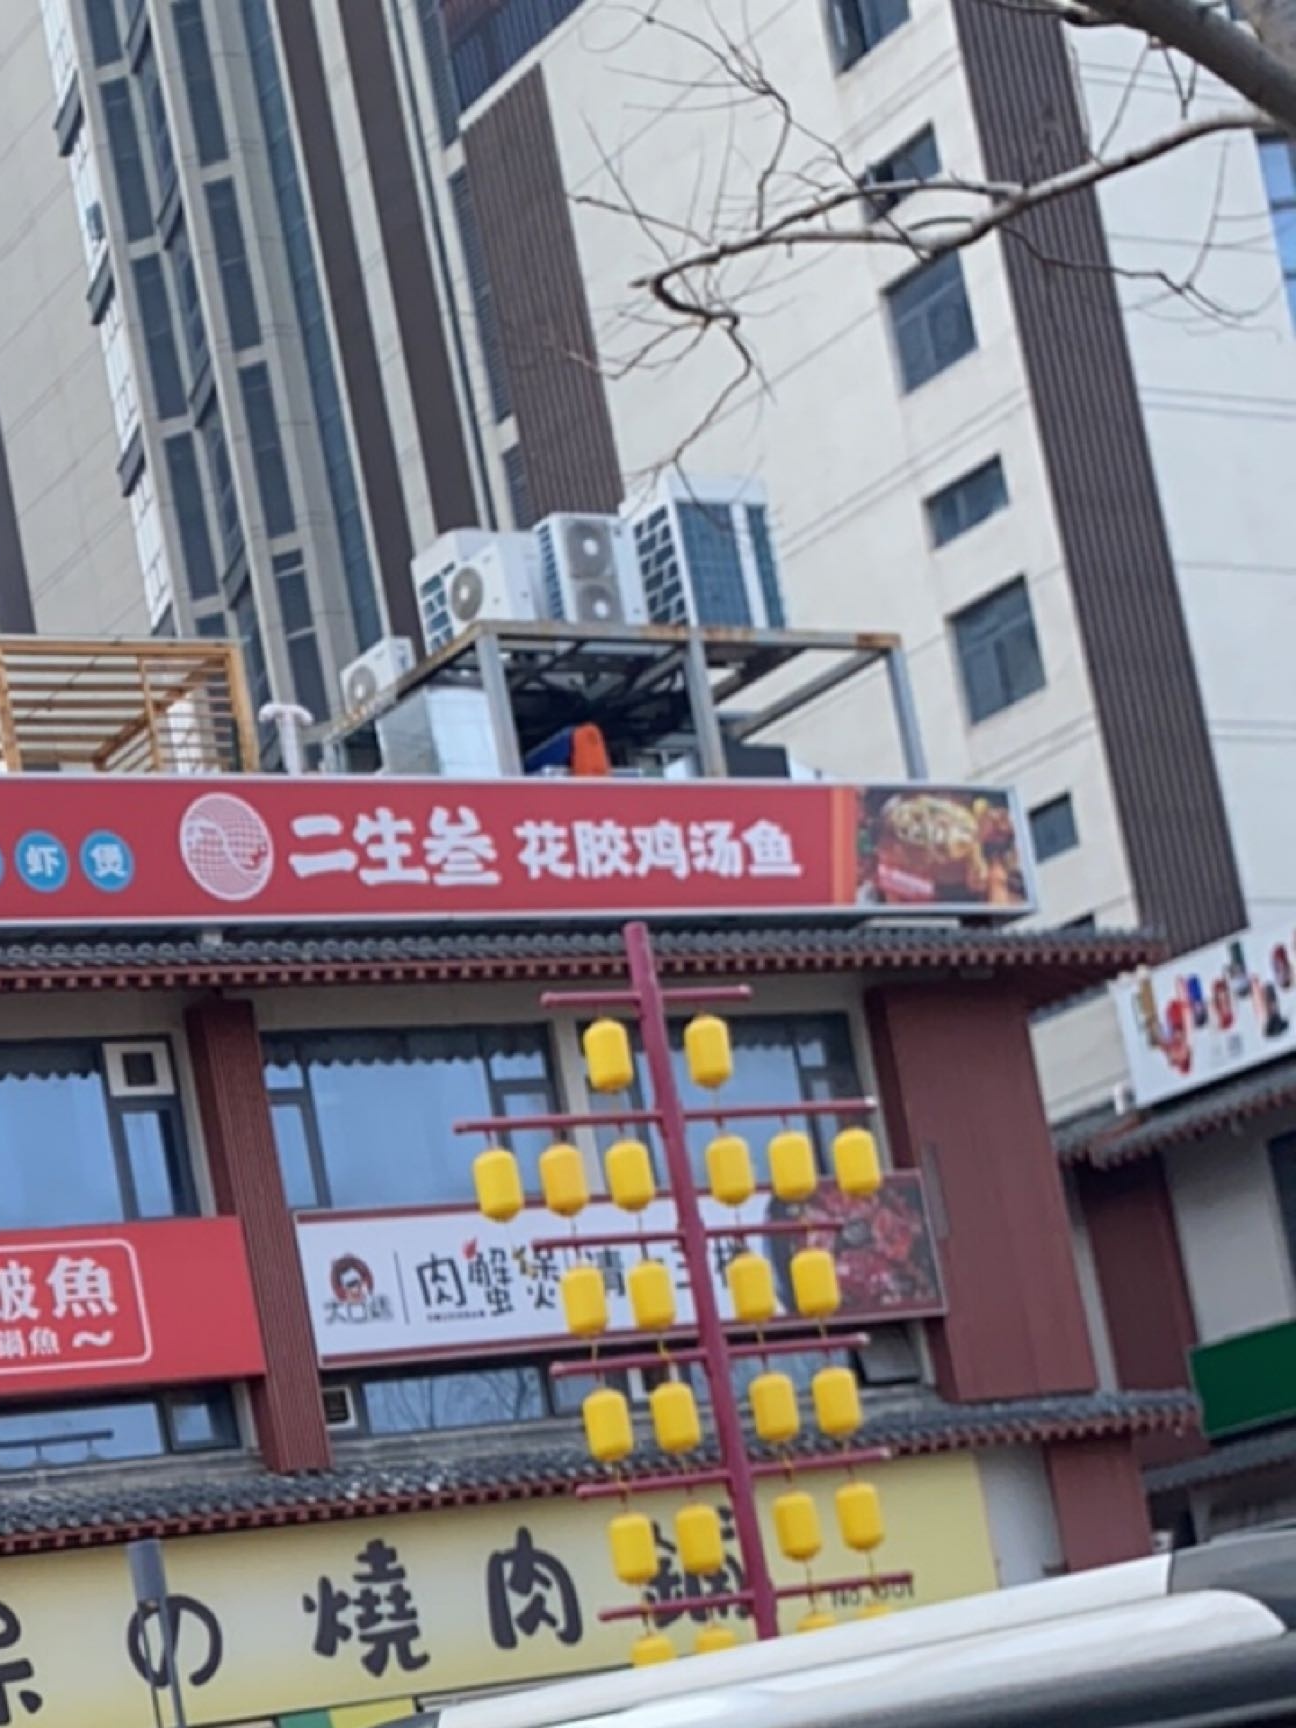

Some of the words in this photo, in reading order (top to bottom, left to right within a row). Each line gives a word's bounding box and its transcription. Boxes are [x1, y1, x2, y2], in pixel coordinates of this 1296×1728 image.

[514, 818, 803, 880] 花胶鸡汤鱼
